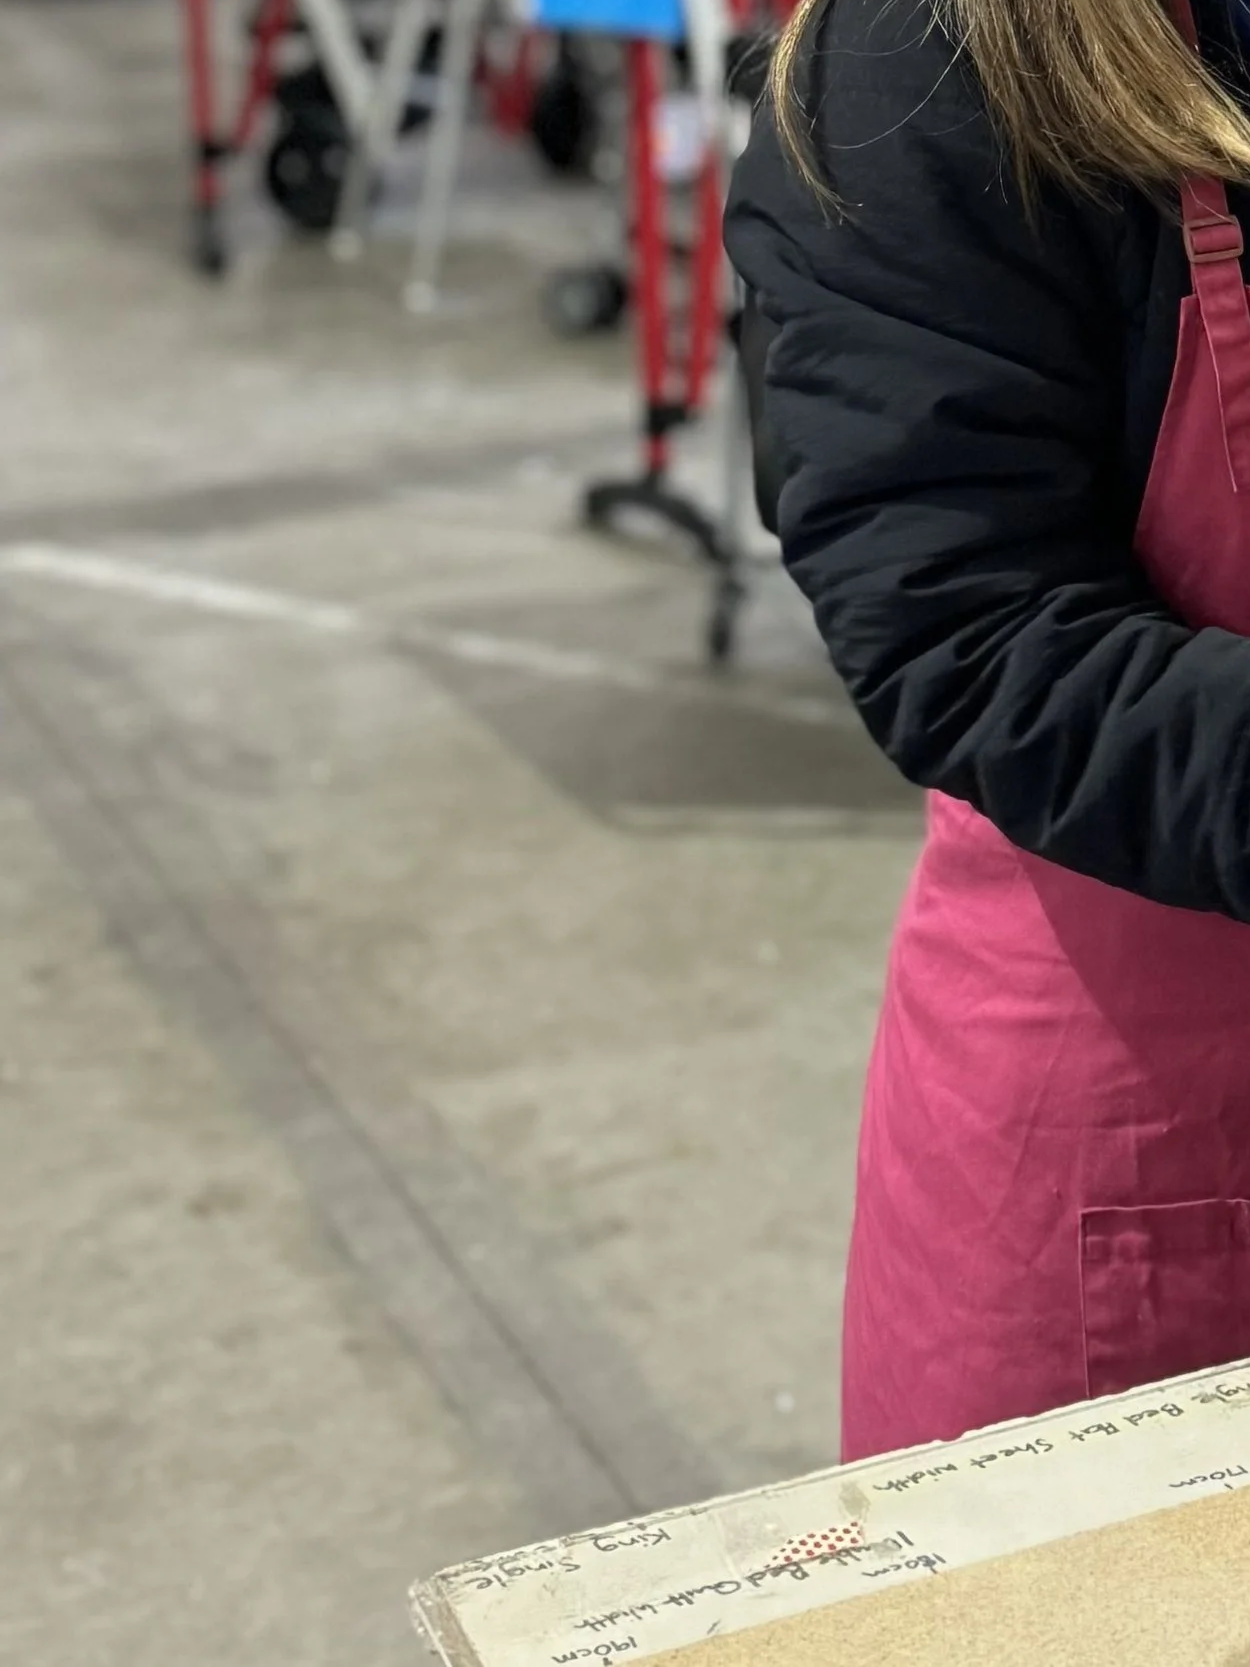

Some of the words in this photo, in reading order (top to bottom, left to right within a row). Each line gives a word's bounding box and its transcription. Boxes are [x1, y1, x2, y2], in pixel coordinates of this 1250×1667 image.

[1123, 1403, 1185, 1427] Bed
[970, 1438, 1054, 1469] Sheet
[1169, 1464, 1249, 1488] 170cm
[593, 1527, 672, 1552] King
[464, 1555, 582, 1589] Single
[552, 1635, 638, 1664] 190cm
